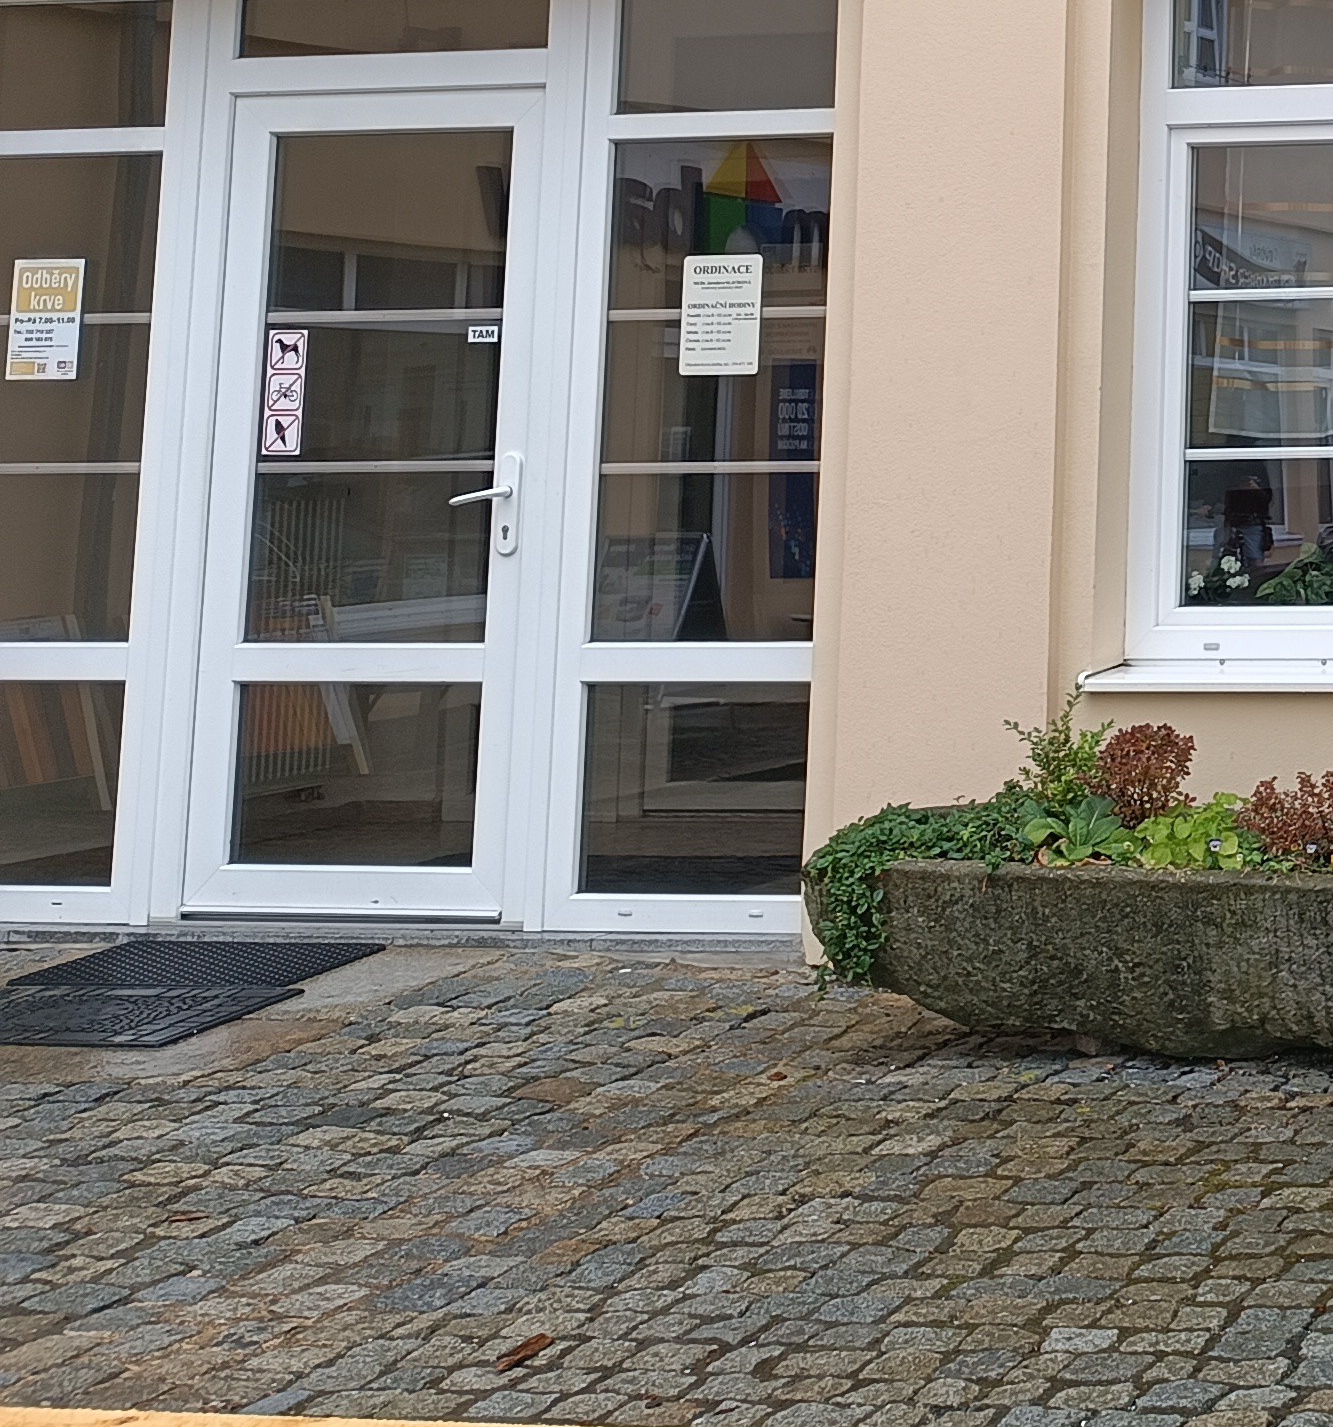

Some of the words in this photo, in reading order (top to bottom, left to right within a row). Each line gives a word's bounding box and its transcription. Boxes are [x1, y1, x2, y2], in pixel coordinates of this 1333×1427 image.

[694, 265, 753, 275] ORDINACE
[22, 270, 75, 292] Odběry
[30, 292, 64, 310] krve
[688, 301, 727, 309] ORDINAČNÍ
[471, 328, 495, 340] TAM
